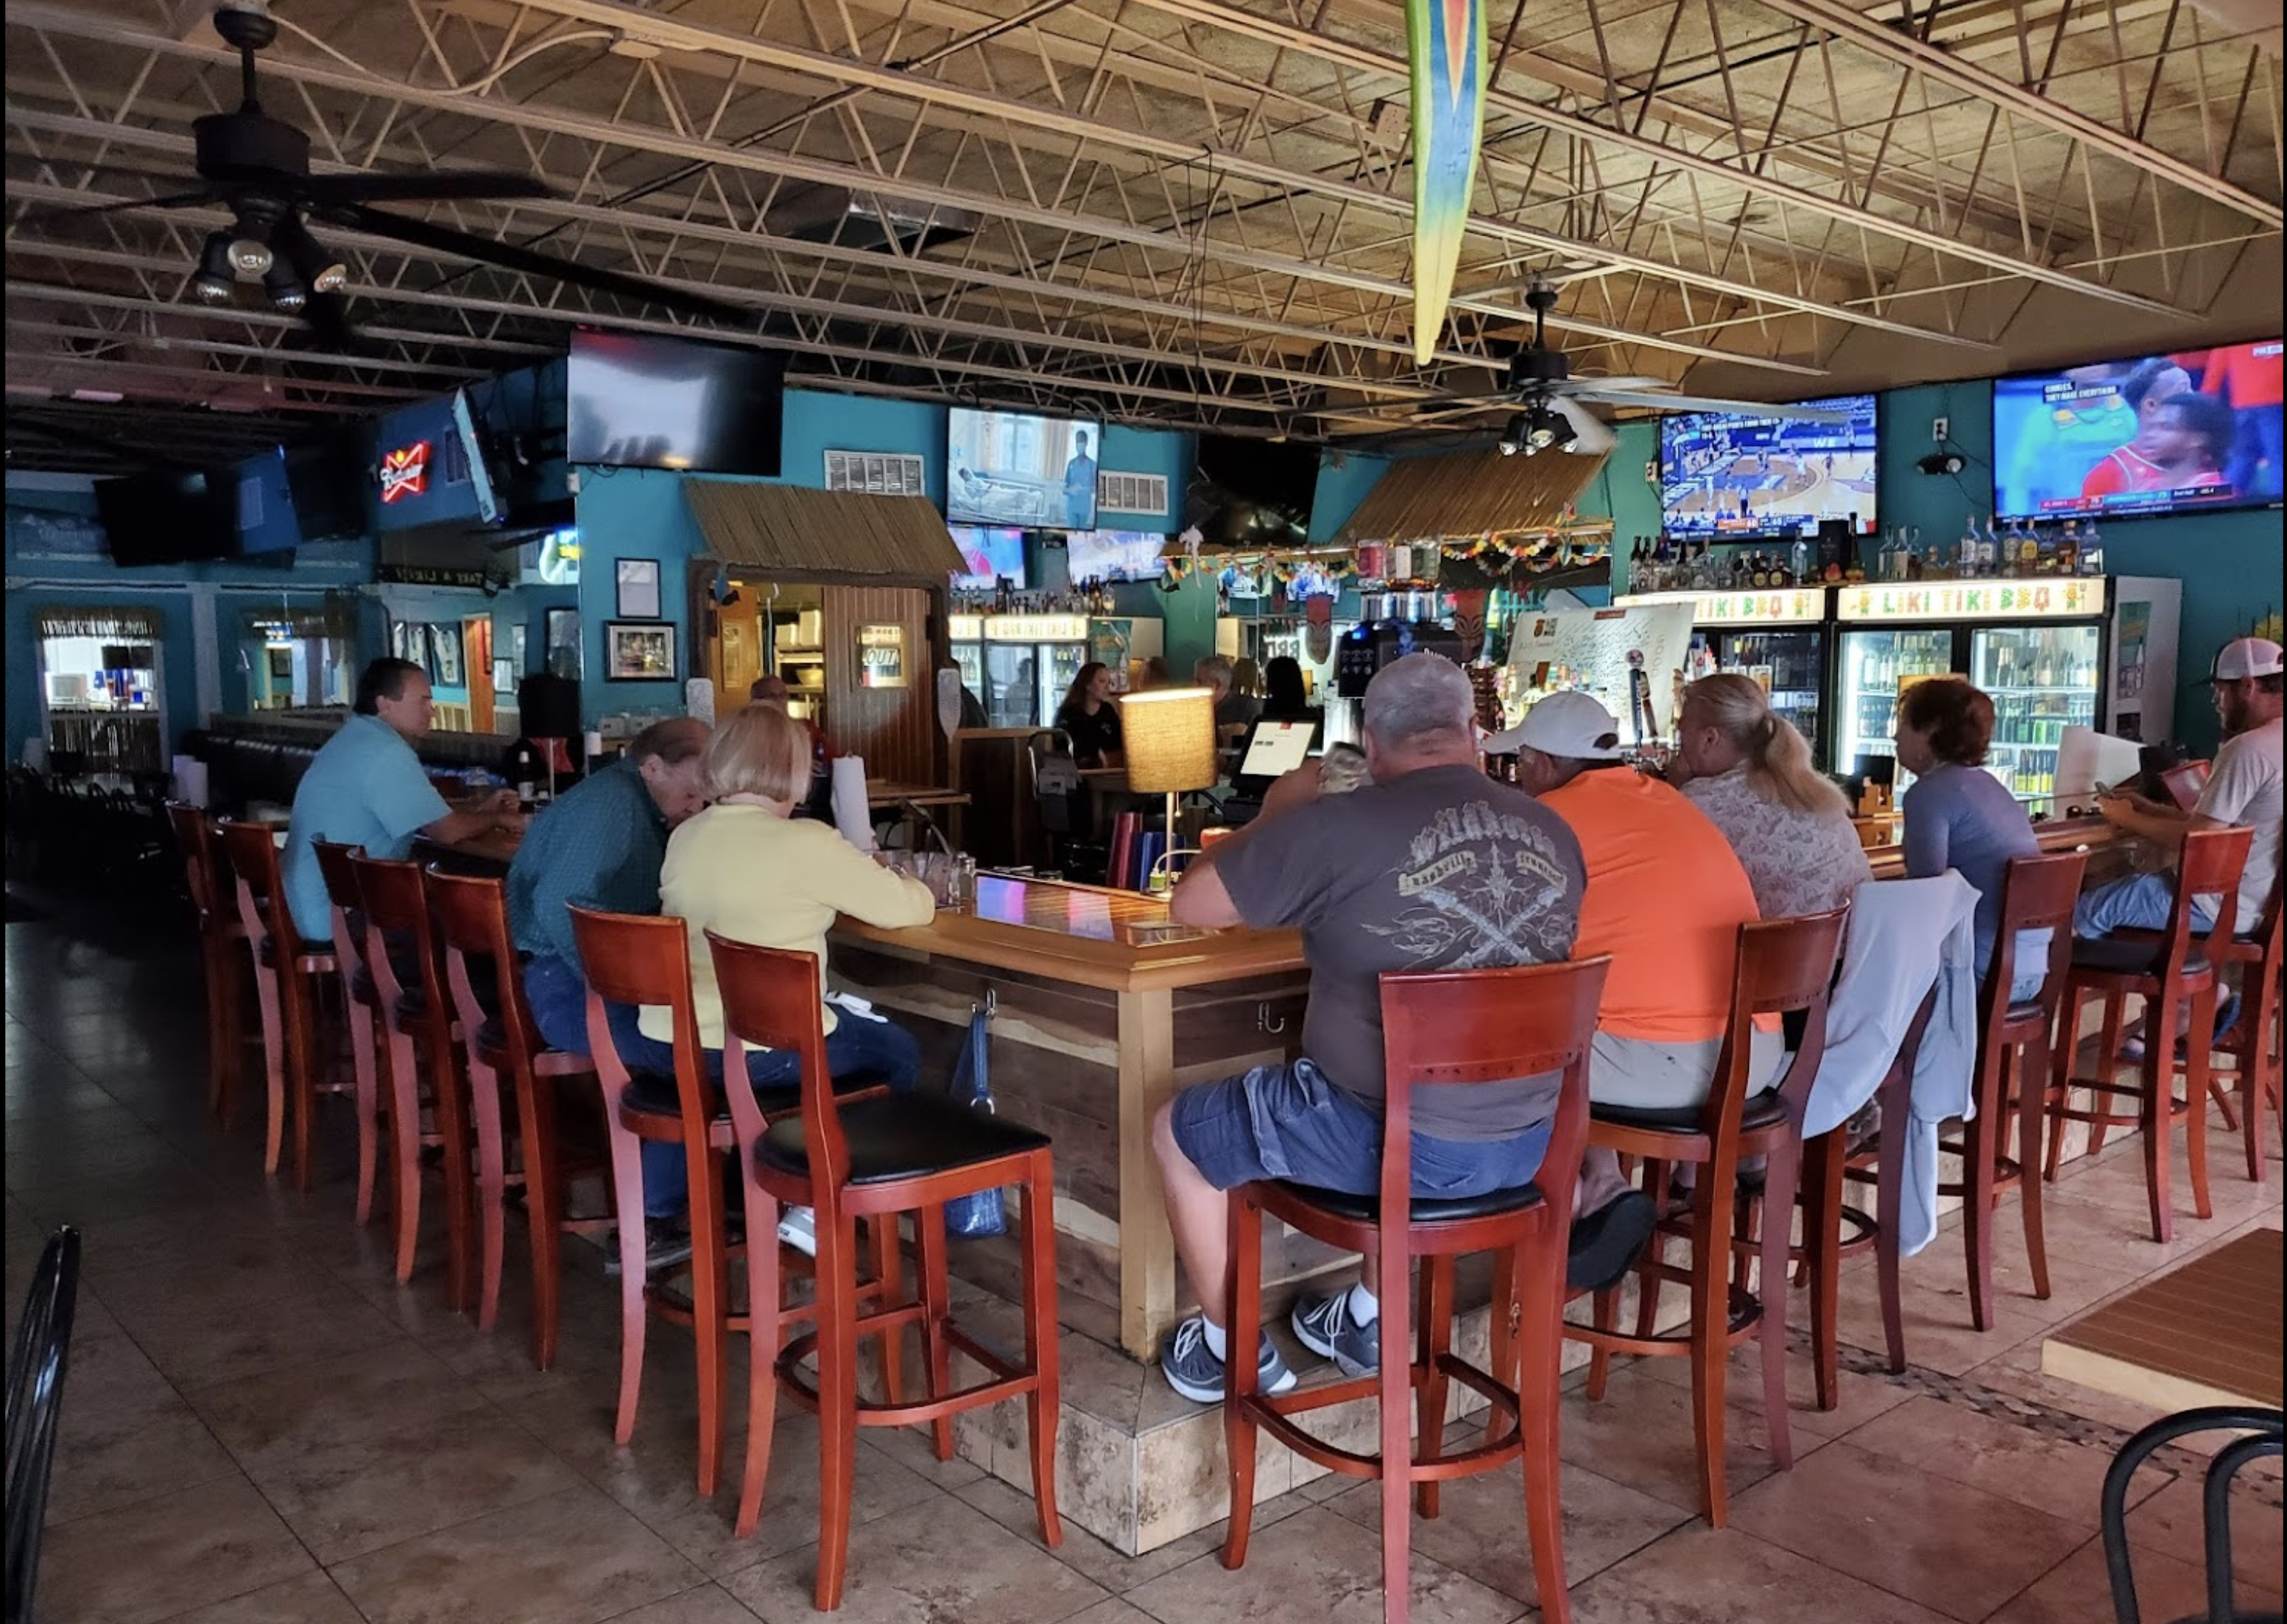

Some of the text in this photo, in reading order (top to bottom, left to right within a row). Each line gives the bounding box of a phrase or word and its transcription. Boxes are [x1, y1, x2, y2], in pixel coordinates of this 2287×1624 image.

[1696, 595, 1783, 619] TIKI BBQ
[1883, 586, 2049, 613] LIKI TIKI BBQ
[867, 650, 896, 665] OUT
